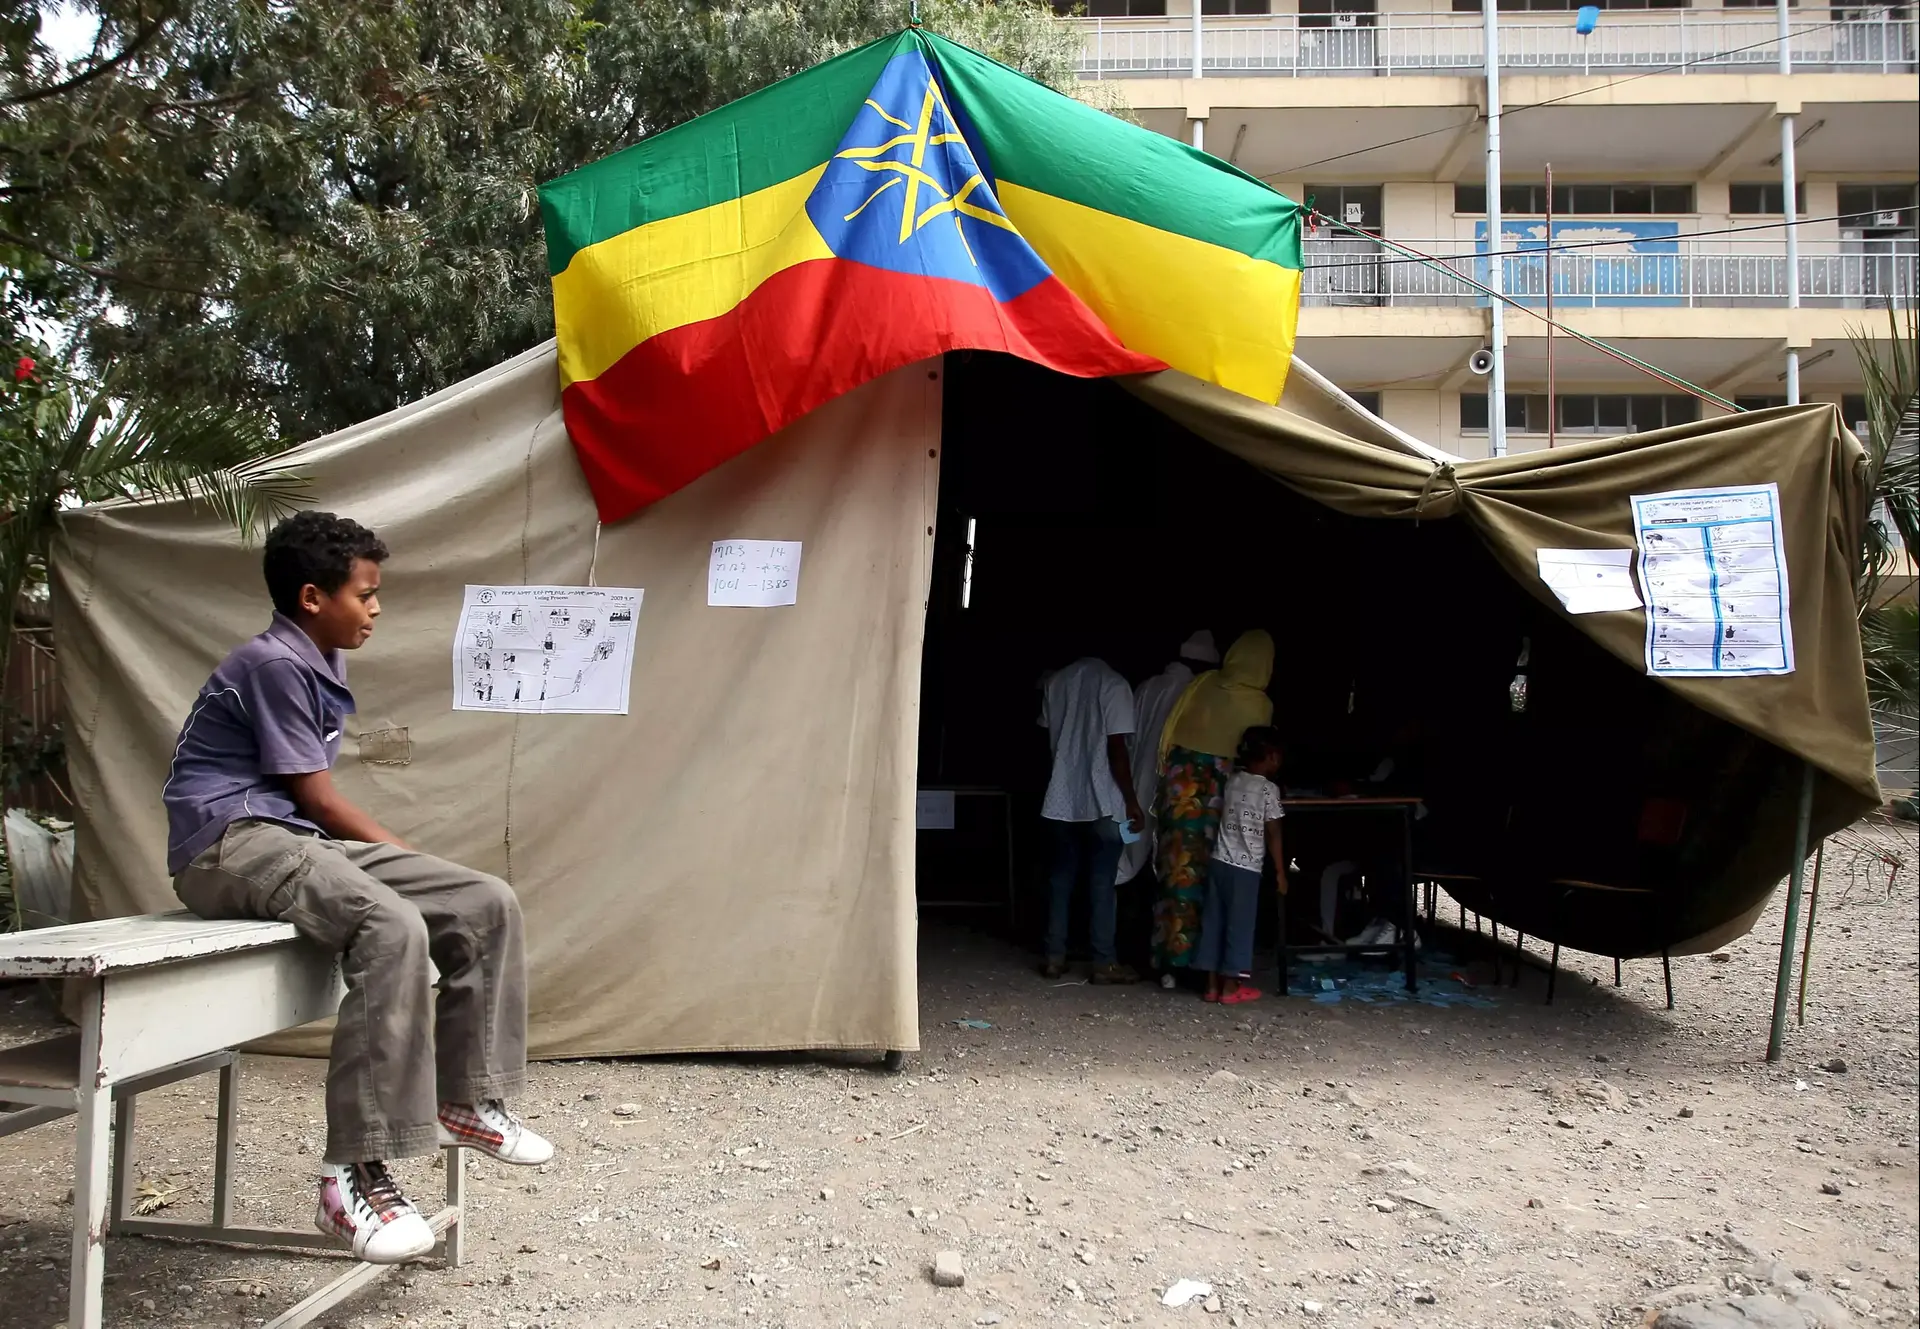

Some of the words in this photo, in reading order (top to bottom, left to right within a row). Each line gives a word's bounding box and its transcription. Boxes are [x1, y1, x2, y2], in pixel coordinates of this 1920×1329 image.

[1348, 207, 1359, 215] 3A
[770, 547, 786, 558] 14
[714, 578, 740, 594] 1001
[762, 579, 790, 591] 1385
